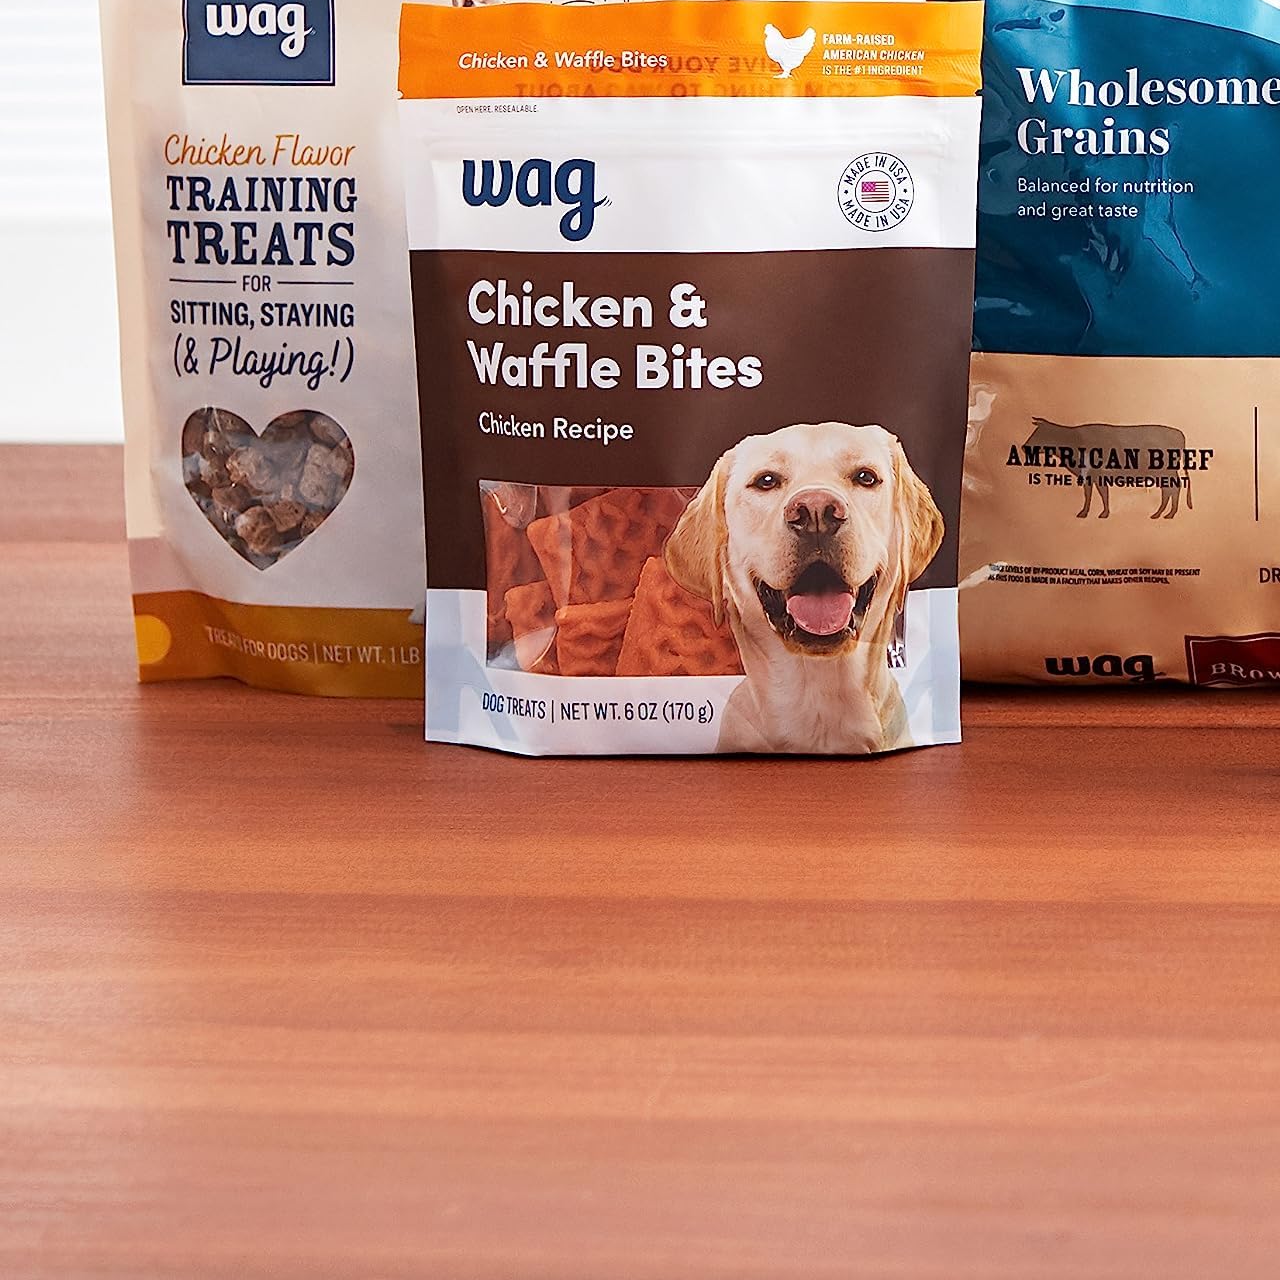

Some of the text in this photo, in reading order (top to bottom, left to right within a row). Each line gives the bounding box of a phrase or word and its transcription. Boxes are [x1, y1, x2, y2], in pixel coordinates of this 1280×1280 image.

[206, 3, 316, 57] wag
[823, 34, 894, 46] FARM-RAISED
[458, 51, 668, 68] Chicken & Waffle Bites
[823, 50, 924, 60] AMERICAN CHICKEN
[823, 66, 923, 75] IS THE #1 INGREDIENT
[165, 133, 355, 166] Chicken Flavor
[1017, 117, 1170, 155] Grains
[844, 156, 907, 185] MADE IN USA
[167, 176, 357, 212] TRAINING
[462, 158, 612, 241] wag
[1018, 178, 1194, 194] Balanced for nutrition
[1018, 203, 1138, 220] and great taste
[167, 221, 354, 266] TREATS
[243, 275, 271, 292] FOR
[171, 300, 354, 329] SITTING, STAYING
[468, 279, 706, 327] Chicken &
[174, 333, 354, 390] (& Playing!)
[467, 341, 763, 389] Waffle Bites
[479, 412, 634, 444] Chicken Recipe
[1006, 445, 1213, 470] AMERICAN BEEF
[1029, 474, 1190, 488] IS THE #1 INGREDIENT
[244, 640, 419, 664] FOR DOGS NET WT. LB
[482, 692, 714, 723] DOG TREATS NET WT. 6 OZ (170 g)
